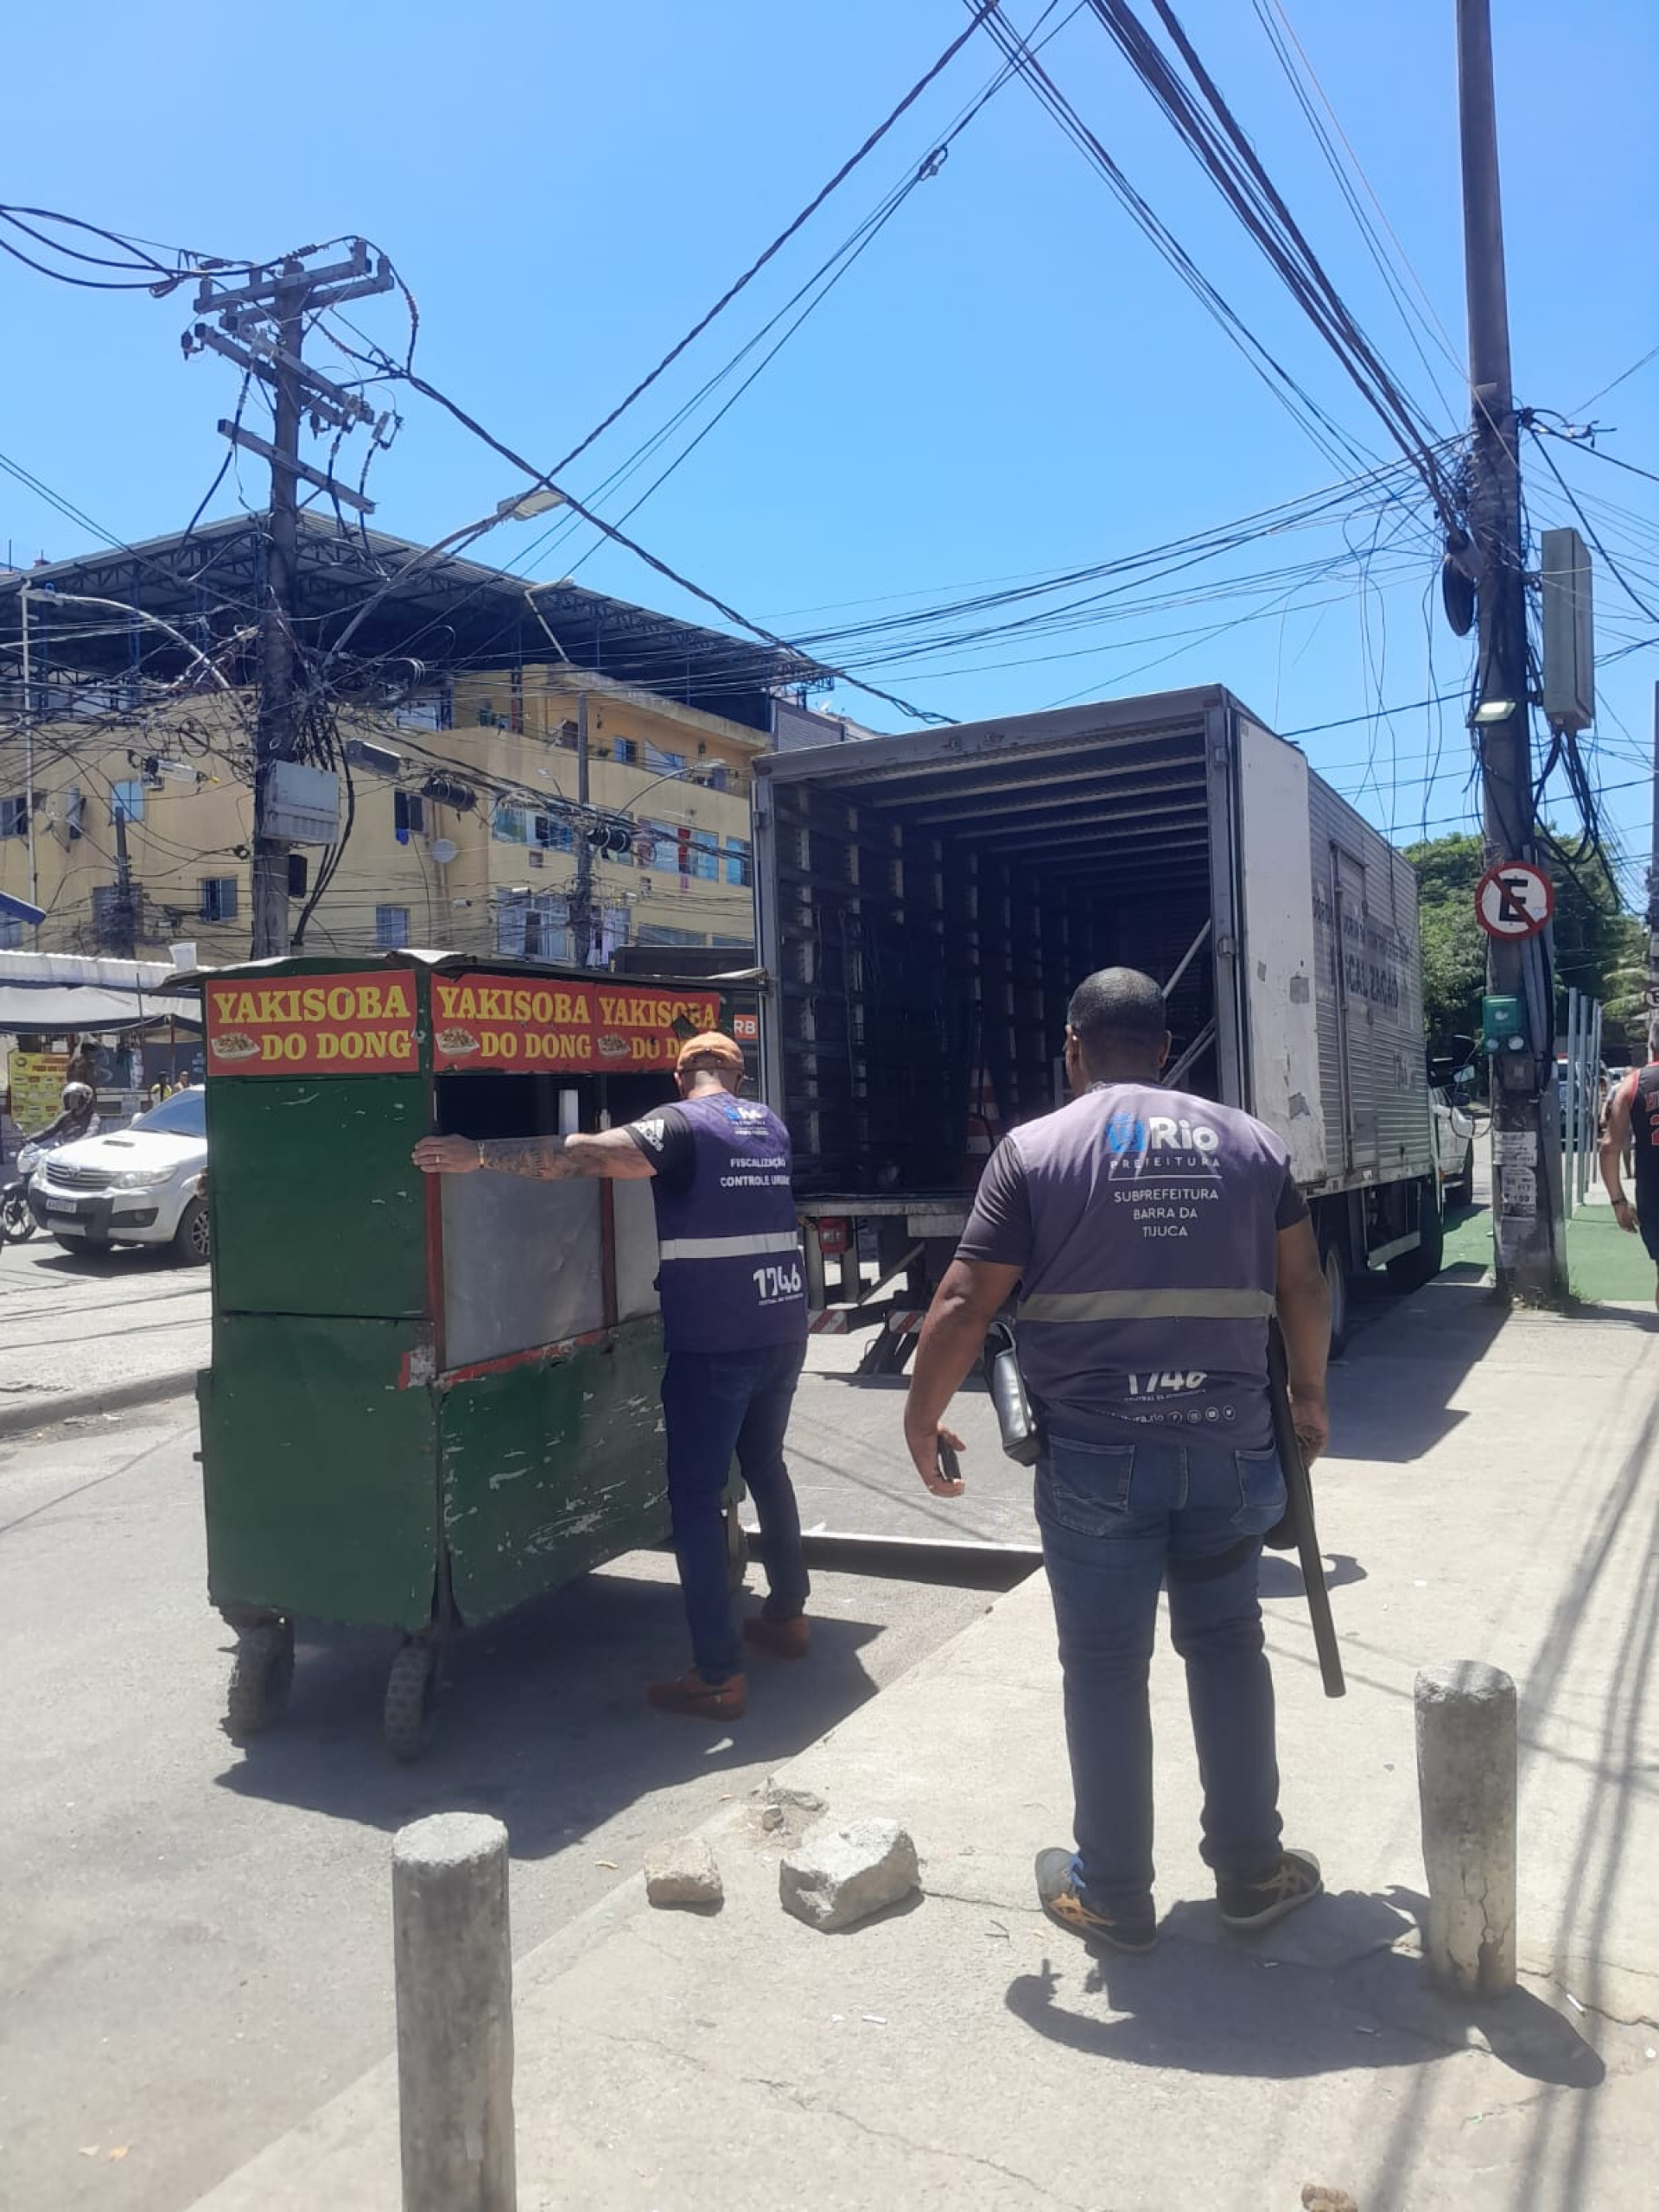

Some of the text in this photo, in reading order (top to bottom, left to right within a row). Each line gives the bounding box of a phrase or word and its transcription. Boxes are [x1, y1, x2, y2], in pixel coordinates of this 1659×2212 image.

[1499, 879, 1528, 921] E
[213, 985, 411, 1024] YAKISOBA
[436, 986, 591, 1024] YAKISOBA
[261, 1030, 412, 1061] DO DONG
[480, 1032, 592, 1058] DO DONG
[632, 1037, 661, 1058] DO
[1148, 1116, 1219, 1151] Rio
[720, 1175, 771, 1187] CONTROLE
[1133, 1206, 1198, 1220] BARRA DA
[753, 1262, 802, 1298] 1746
